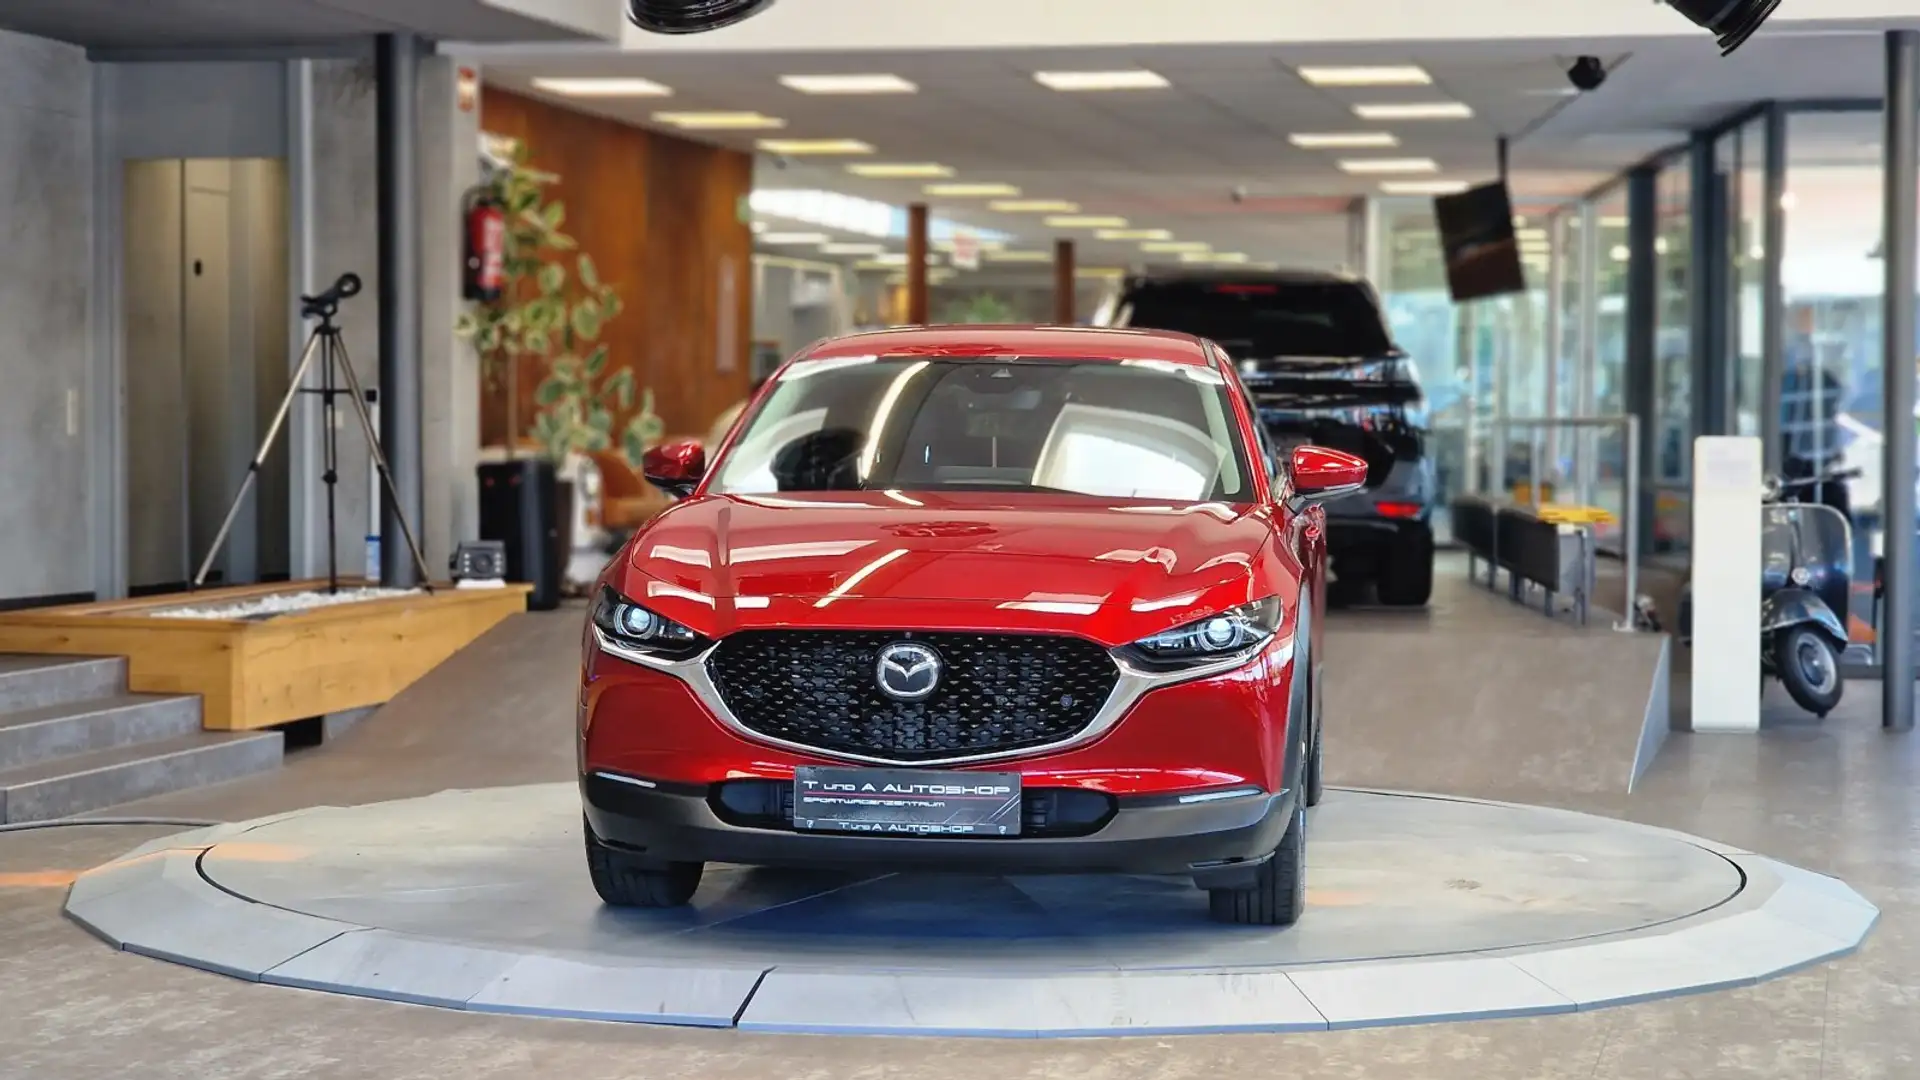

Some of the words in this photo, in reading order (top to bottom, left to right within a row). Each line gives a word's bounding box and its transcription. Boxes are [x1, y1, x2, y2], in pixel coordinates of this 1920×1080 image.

[802, 780, 819, 790] T
[861, 782, 877, 792] A
[882, 783, 1011, 795] AUTOSHOP
[838, 821, 850, 830] T
[871, 823, 883, 831] A
[887, 823, 975, 833] AUTOSHOP
